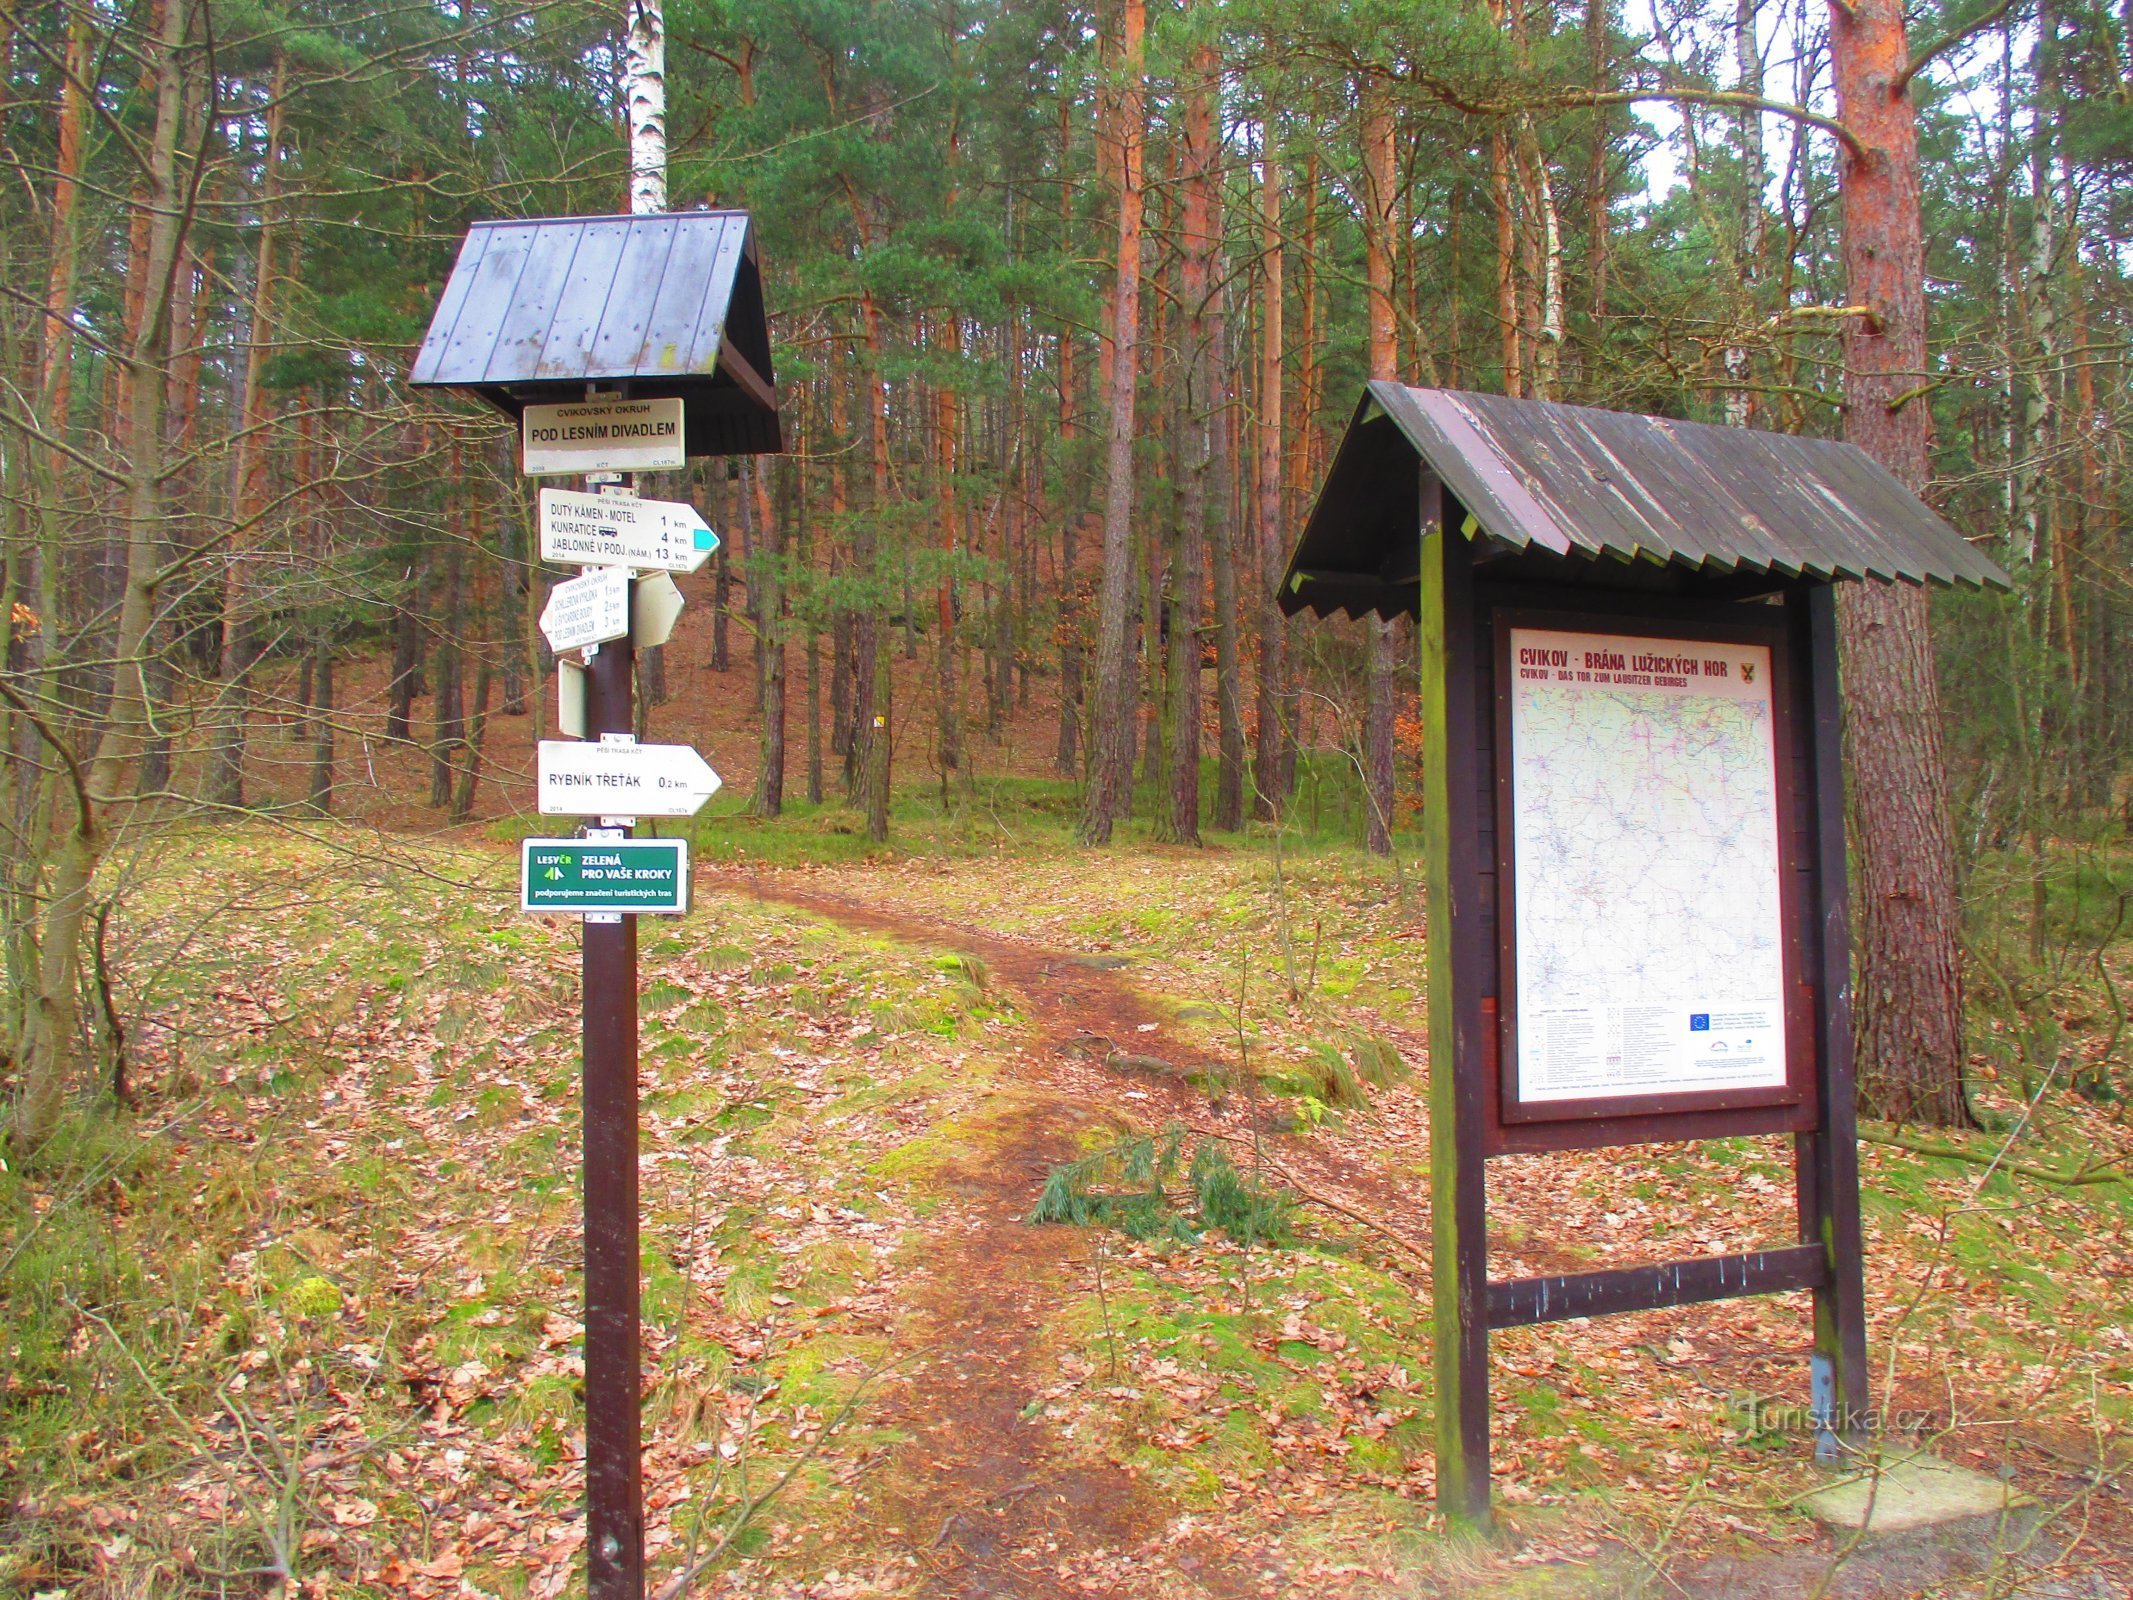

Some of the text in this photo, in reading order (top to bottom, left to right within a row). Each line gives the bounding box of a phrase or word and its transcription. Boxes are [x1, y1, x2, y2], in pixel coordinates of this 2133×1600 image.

[557, 404, 650, 417] CVIKOVSKÝ OKRUH
[532, 422, 675, 442] POD LESNÍM DIVADLEM
[551, 502, 573, 516] DUTÝ
[575, 505, 603, 520] KÁMEN
[609, 510, 636, 524] MOTEL
[660, 515, 667, 527] 1
[674, 520, 687, 529] km
[551, 521, 687, 545] KUNRATICE 4 km
[551, 538, 595, 553] JABLONNÉ
[597, 542, 602, 553] V
[655, 548, 669, 560] 13
[675, 552, 688, 562] km
[1520, 648, 1568, 668] CVIKOV
[1585, 650, 1626, 671] BRÁNA
[1632, 652, 1699, 676] LUŽICKÝCH
[1704, 660, 1728, 677] HOR
[1520, 668, 1549, 680] CVIKOV
[1558, 670, 1573, 681] DAS
[1577, 671, 1591, 682] TOR
[1594, 672, 1611, 683] ZUM
[1613, 674, 1651, 686] LAUSITZER
[1654, 676, 1688, 688] GEBIRGES
[549, 772, 593, 786] RYBNÍK
[596, 773, 641, 787] TŘEŤÁK
[581, 853, 622, 866] ZELENÁ
[581, 867, 672, 880] PRO VAŠE KROKY
[535, 888, 672, 898] podporujeme značení turistických tras
